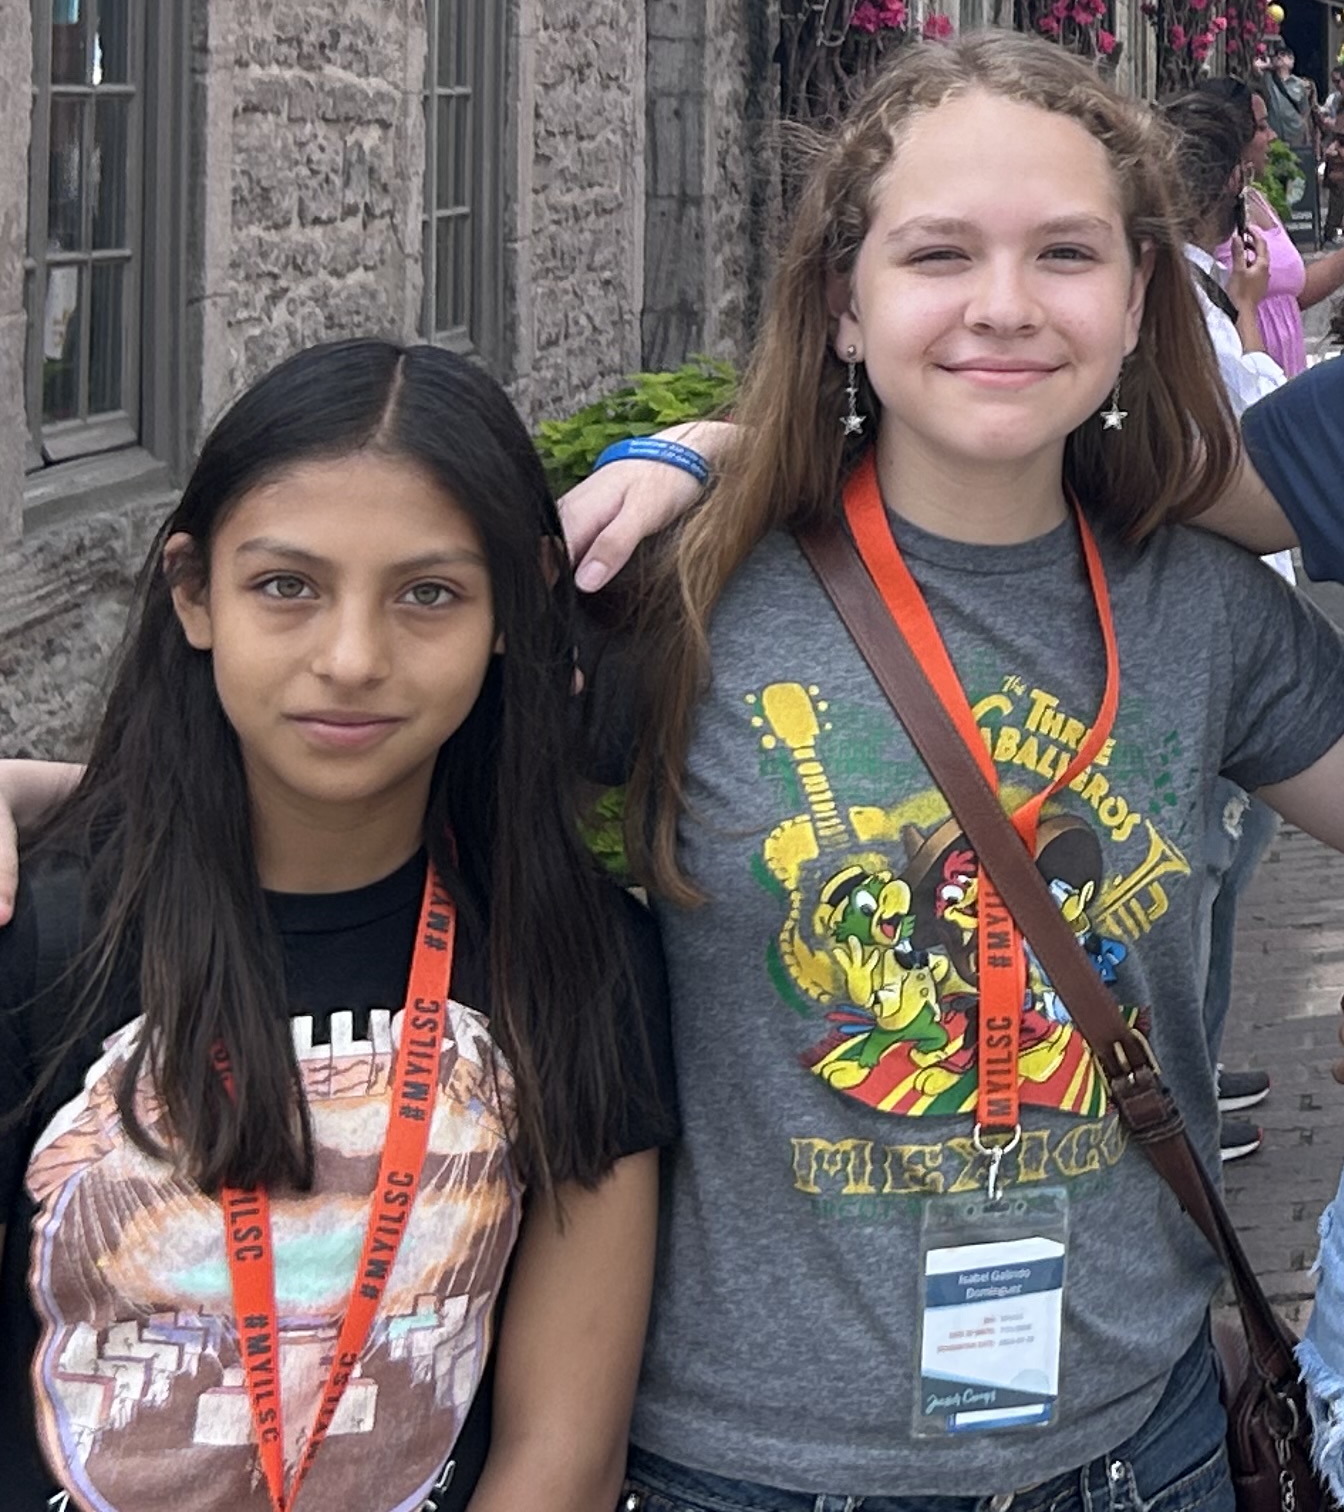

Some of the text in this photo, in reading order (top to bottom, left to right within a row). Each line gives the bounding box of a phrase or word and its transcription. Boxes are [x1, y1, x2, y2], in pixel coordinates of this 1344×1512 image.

[399, 997, 442, 1122] #MYILSC
[986, 1015, 1013, 1118] MYILSC
[790, 1114, 1132, 1195] MEXICO
[228, 1194, 264, 1262] ILSC
[358, 1170, 415, 1301] #MYILSC
[243, 1313, 281, 1443] #MYILSC
